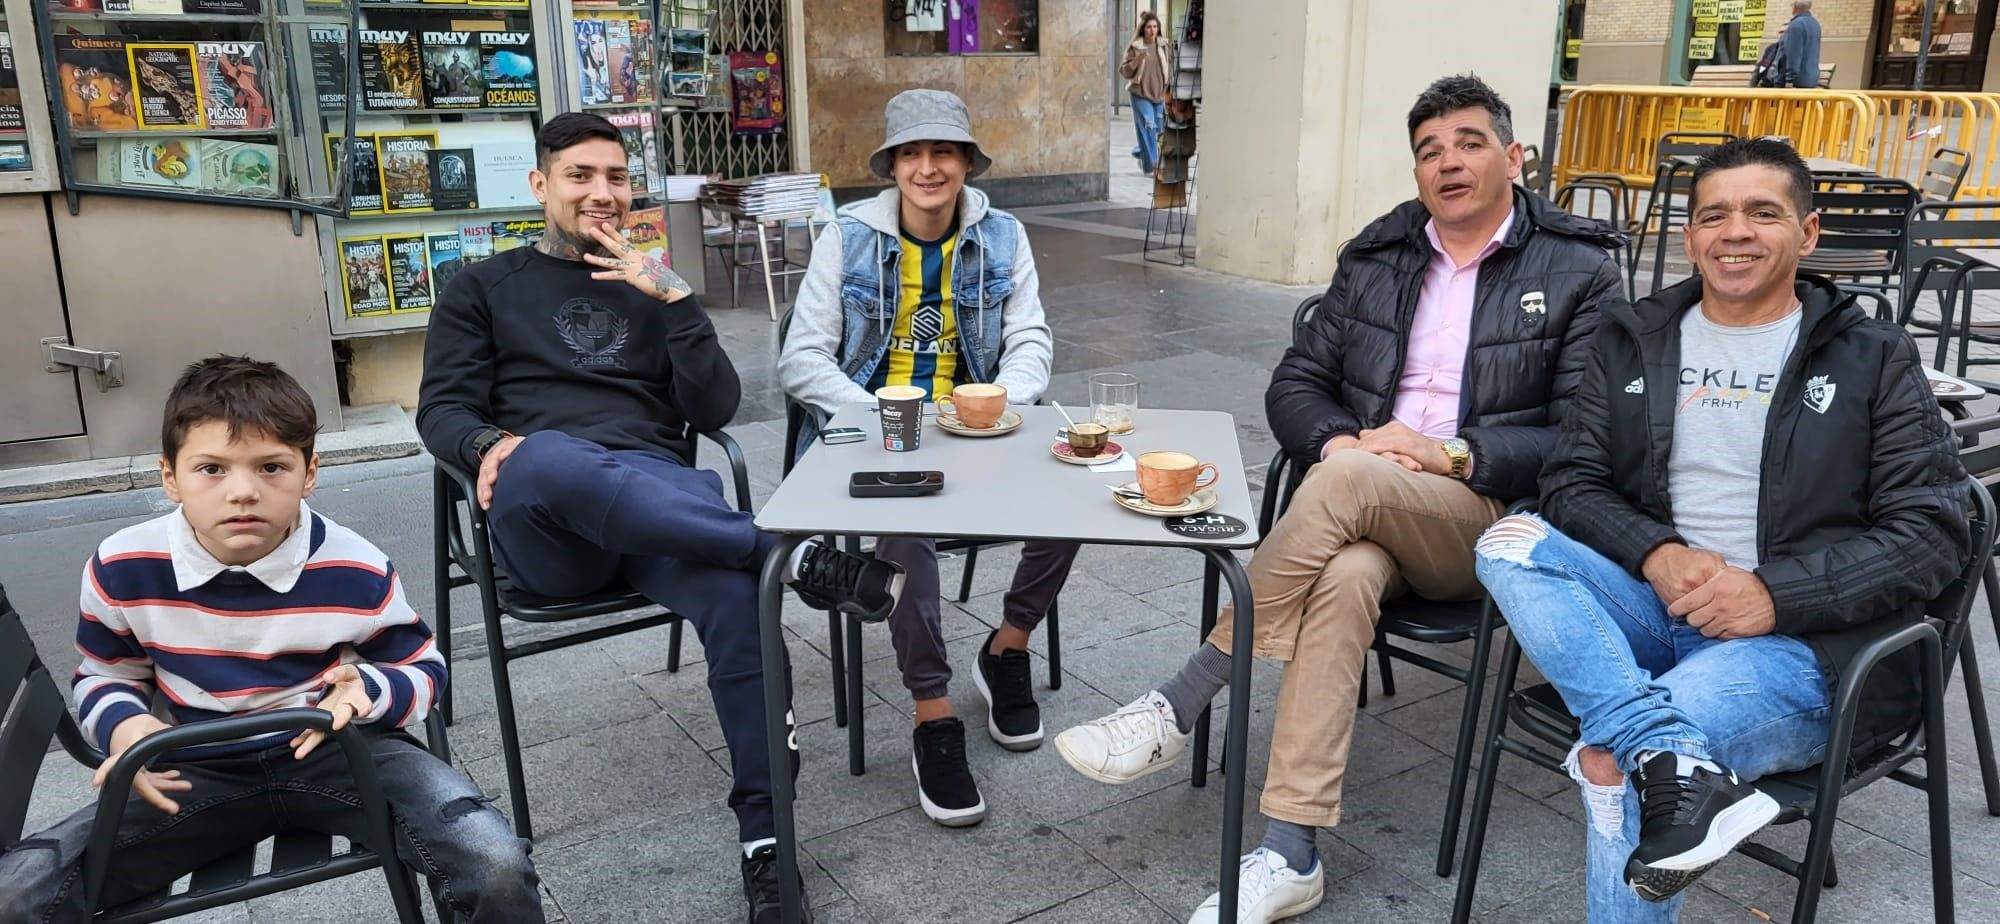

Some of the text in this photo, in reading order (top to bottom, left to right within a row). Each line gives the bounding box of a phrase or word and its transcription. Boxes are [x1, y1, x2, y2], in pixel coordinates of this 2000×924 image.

[71, 38, 122, 48] Quimera
[360, 30, 409, 44] muy
[423, 32, 470, 45] muy
[480, 33, 530, 45] muy
[198, 43, 256, 58] muy
[433, 96, 480, 104] CONQUISTADORES
[486, 86, 536, 103] OCÉANOS
[208, 107, 247, 119] PICASSO
[387, 140, 431, 151] HISTORIA
[435, 239, 459, 251] HISTO
[353, 302, 371, 310] EDAD
[581, 356, 615, 365] adidas
[1701, 398, 1743, 411] FRHT
